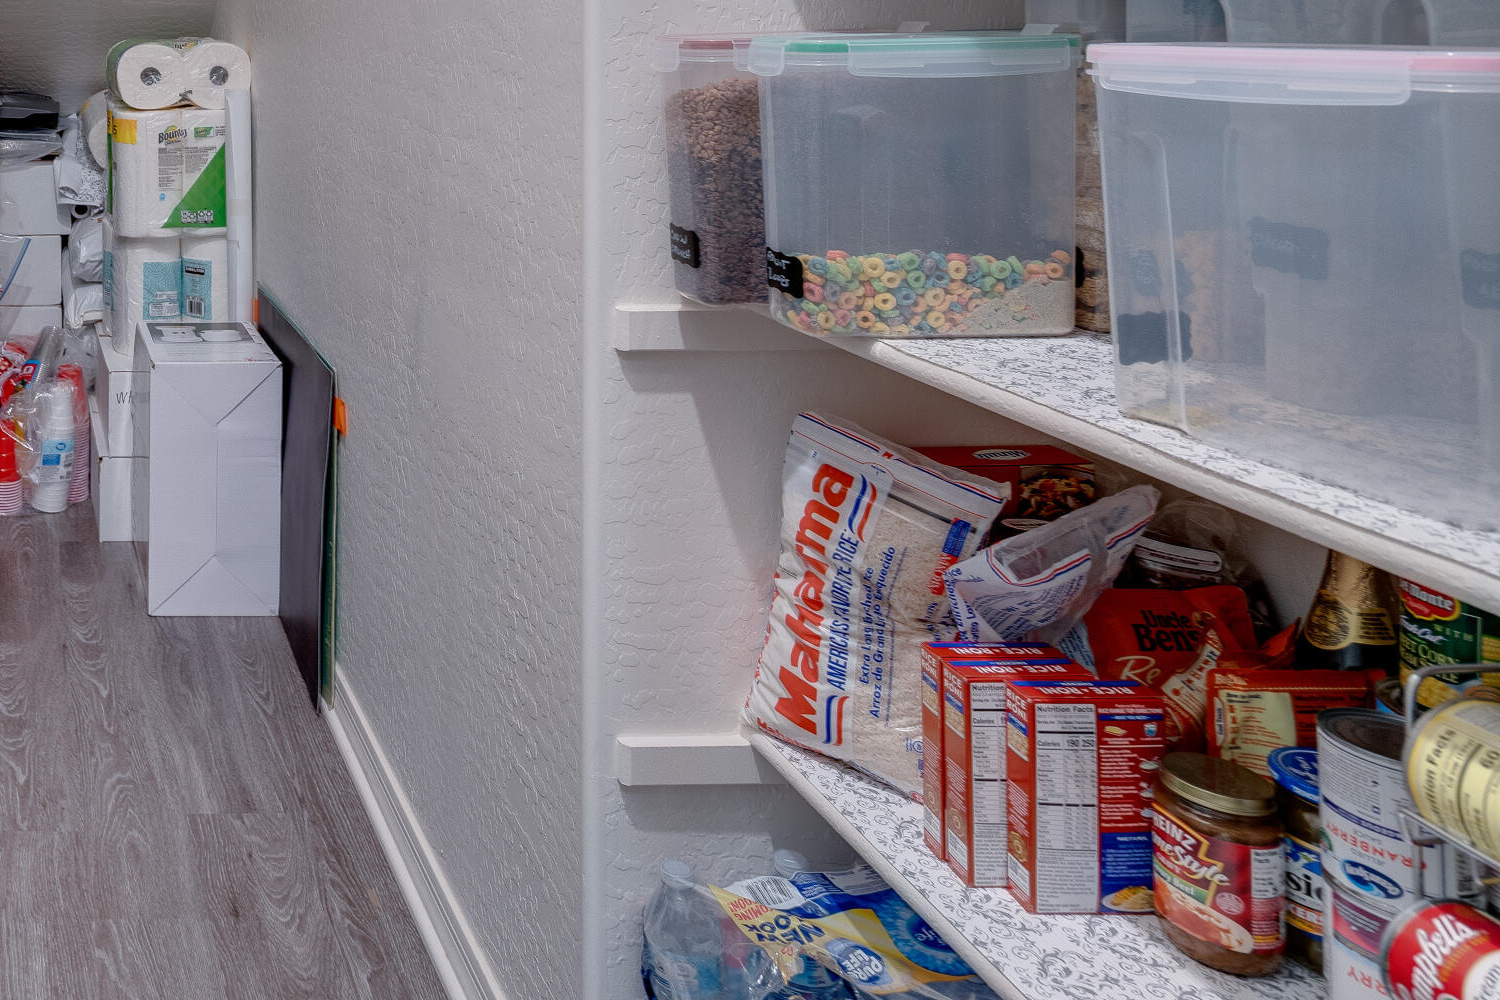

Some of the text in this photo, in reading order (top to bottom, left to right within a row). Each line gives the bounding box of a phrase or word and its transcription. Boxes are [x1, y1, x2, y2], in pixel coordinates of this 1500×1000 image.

[158, 127, 189, 144] Bounty
[833, 536, 859, 567] RICE
[1140, 609, 1194, 629] Uncle
[826, 617, 850, 691] AMERICA'S
[943, 668, 963, 689] RICE
[1021, 665, 1067, 673] RICE
[944, 677, 964, 700] RONI
[972, 684, 1005, 692] Nutrition
[1035, 687, 1136, 695] RONI RICE
[868, 684, 883, 718] Arroz
[1006, 688, 1028, 711] RICE
[1037, 705, 1071, 713] Nutrition
[1073, 705, 1094, 713] Facts
[1006, 699, 1029, 722] RONI
